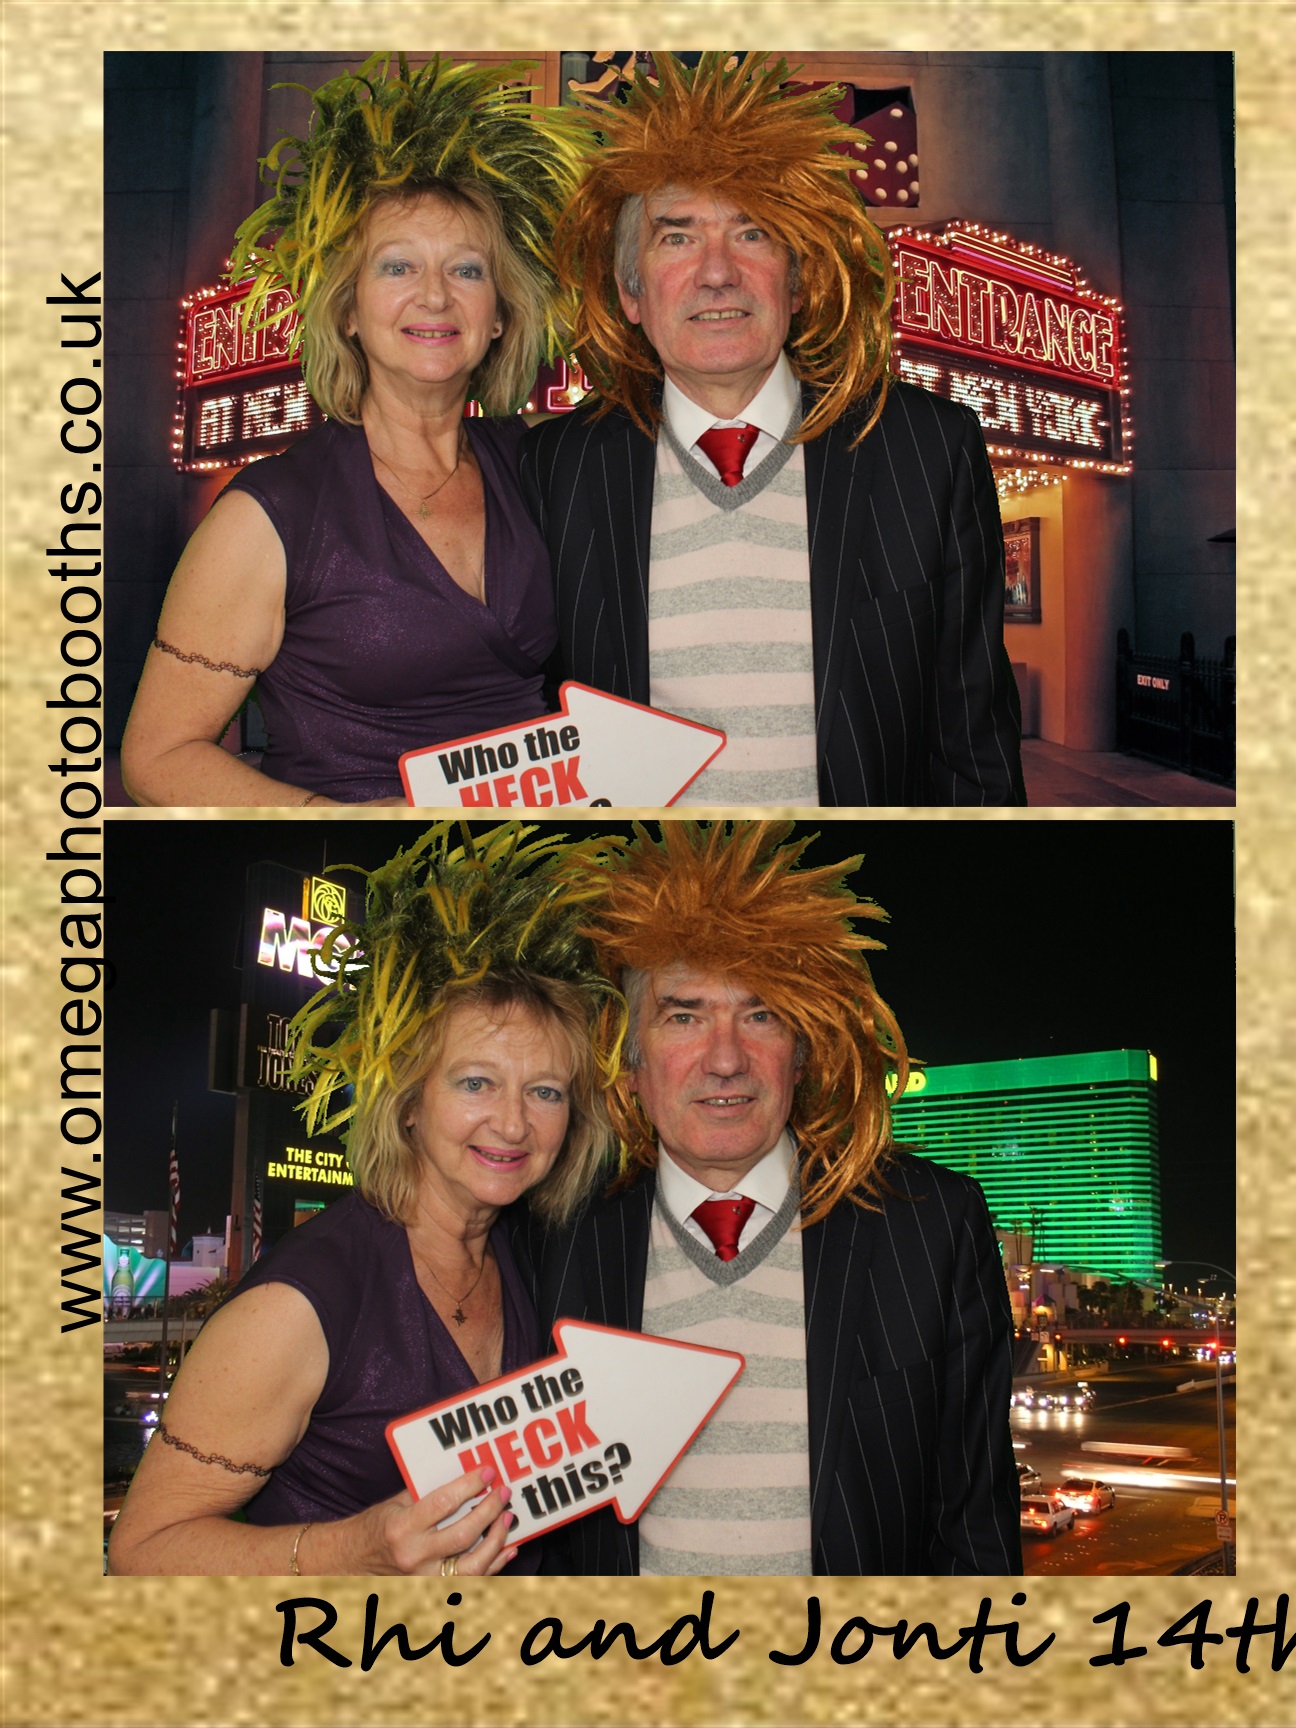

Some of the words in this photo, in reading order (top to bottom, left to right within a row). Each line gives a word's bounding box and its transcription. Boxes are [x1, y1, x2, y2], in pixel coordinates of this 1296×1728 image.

[192, 288, 305, 375] ENTR
[899, 250, 1115, 378] ENTRANCE
[1137, 674, 1151, 686] EXIT
[1152, 677, 1170, 690] ONLY
[437, 742, 519, 785] Who
[523, 725, 581, 762] the
[257, 907, 370, 991] MG
[286, 1146, 313, 1165] THE
[315, 1151, 344, 1169] CITY
[428, 1394, 520, 1452] Who
[521, 1367, 586, 1413] the
[457, 1399, 602, 1496] HECK
[521, 1441, 633, 1520] this?
